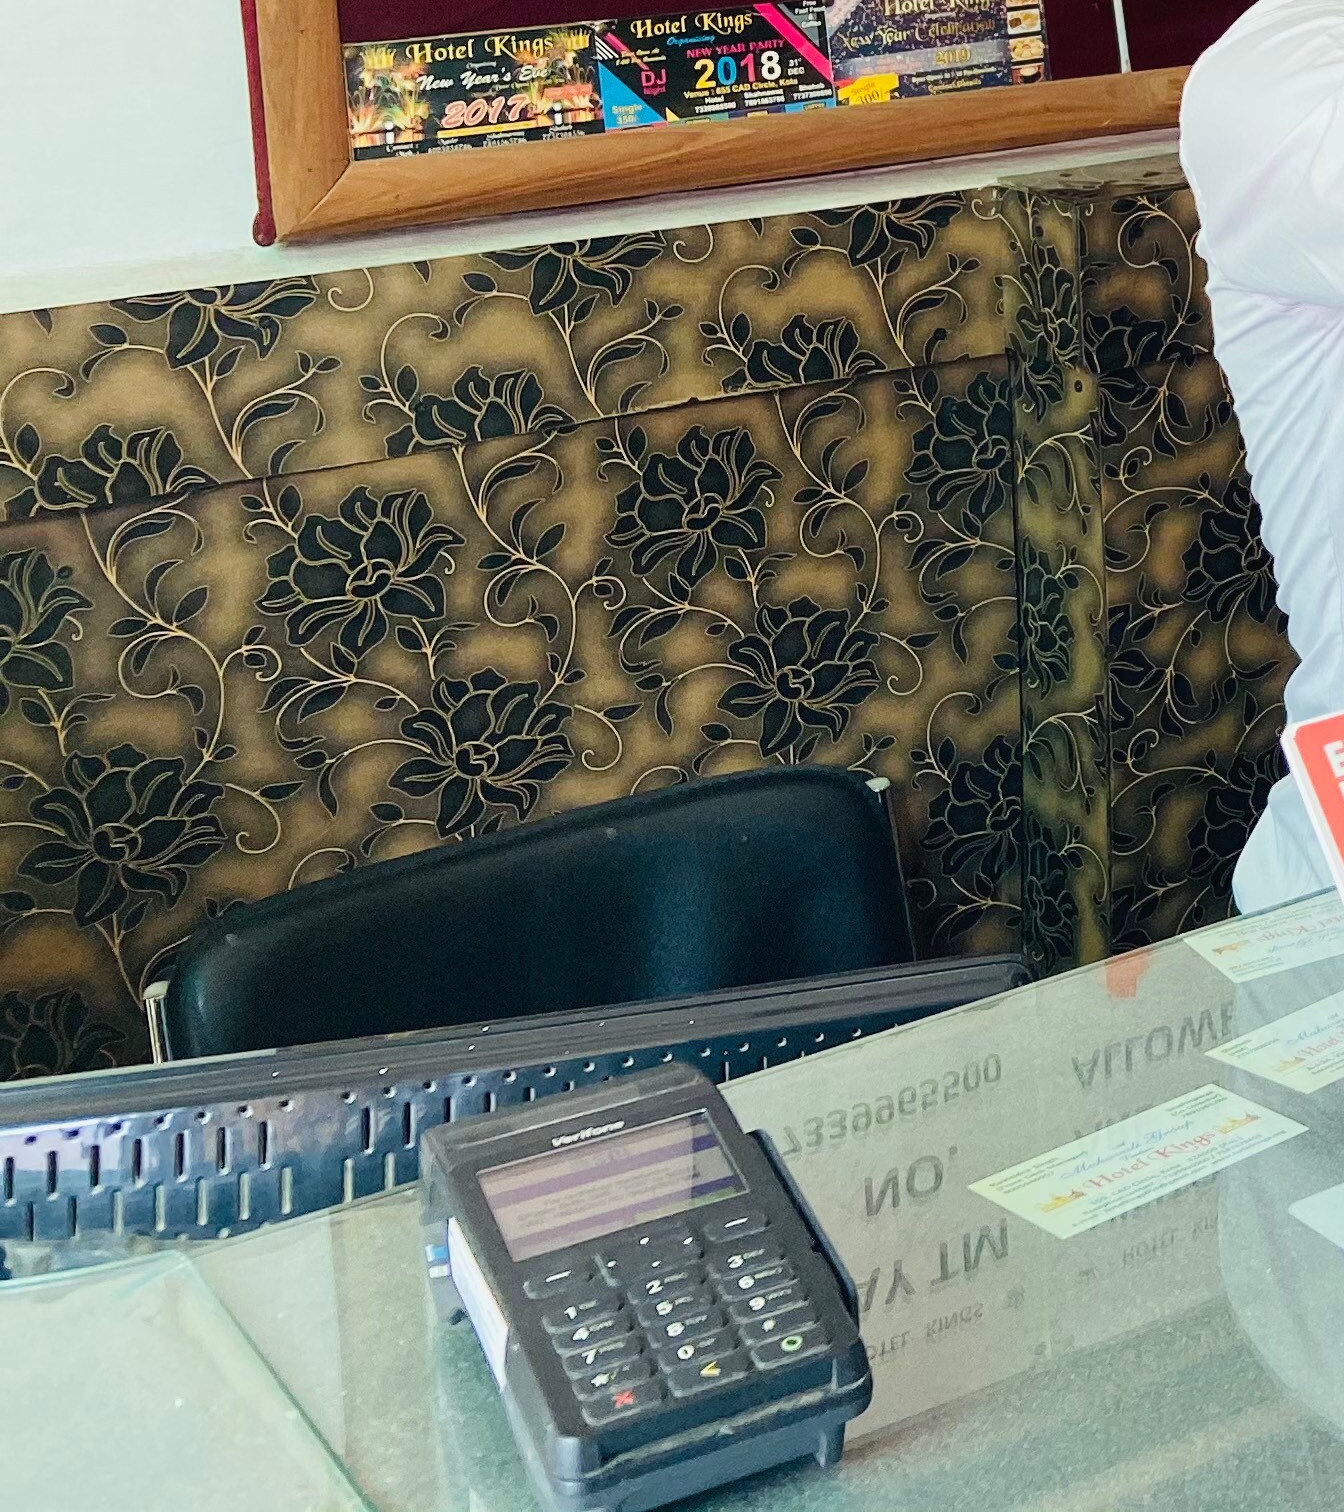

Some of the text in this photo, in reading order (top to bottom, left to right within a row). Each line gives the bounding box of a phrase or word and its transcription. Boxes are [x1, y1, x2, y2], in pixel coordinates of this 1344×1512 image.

[630, 11, 753, 38] Hotel Kings
[876, 27, 911, 46] Year
[406, 34, 553, 64] Hotel Kings
[686, 39, 785, 59] NEW YEAR PARTY
[934, 43, 971, 66] 2019
[416, 75, 454, 91] New
[460, 67, 512, 89] Year's
[519, 64, 550, 80] Eve
[640, 68, 667, 87] DJ
[693, 50, 782, 89] 2018
[441, 93, 532, 129] 2017
[1083, 1158, 1149, 1189] Hotel
[1148, 1130, 1217, 1163] Kings
